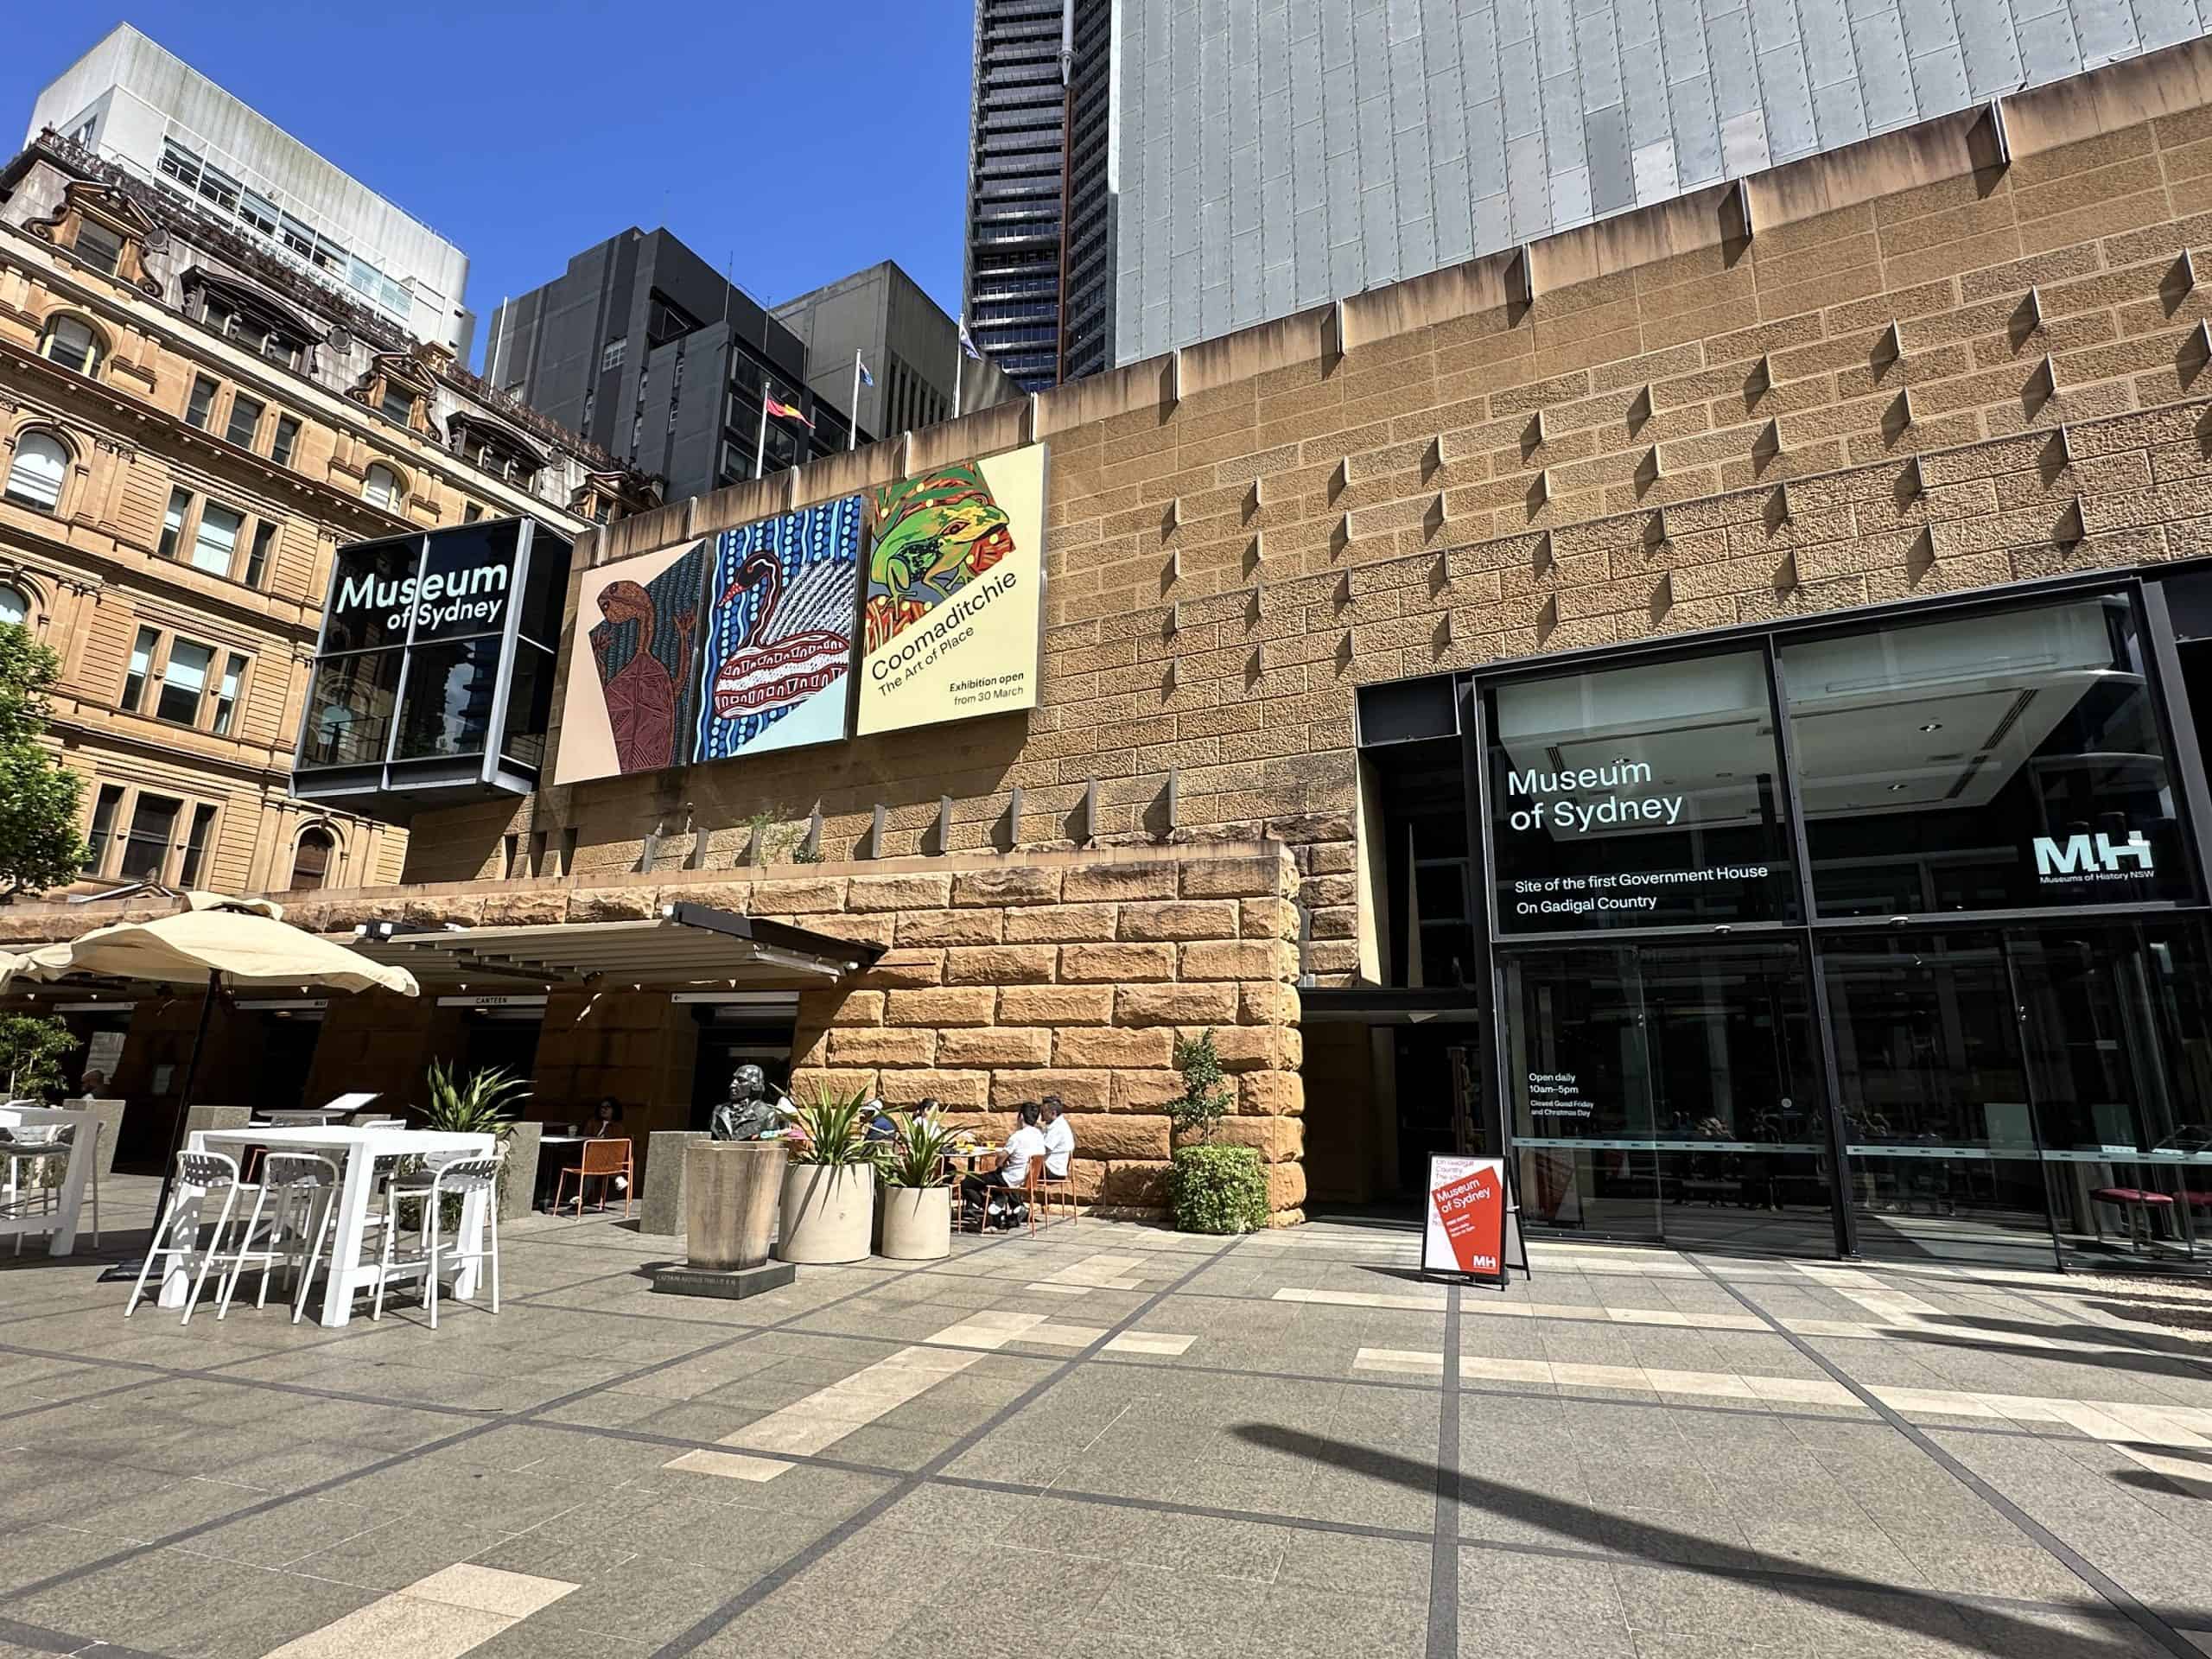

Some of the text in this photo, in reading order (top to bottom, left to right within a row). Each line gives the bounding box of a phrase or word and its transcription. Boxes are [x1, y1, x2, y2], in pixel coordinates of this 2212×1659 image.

[336, 563, 507, 613] Museum
[386, 598, 503, 630] of Sydney
[872, 572, 1016, 681] Coomaditchie
[878, 626, 975, 696] The Art of Place
[950, 671, 1024, 692] Exhibition open
[954, 685, 1024, 706] from 30 March
[1508, 761, 1652, 796] Museum
[1510, 795, 1682, 832] of Sydney
[2032, 830, 2153, 874] MH
[1515, 865, 1768, 893] Site of the first Government House
[2039, 870, 2154, 884] Museums of History NSW
[1516, 894, 1657, 915] On Gadigal Country
[1529, 1072, 1576, 1084] Open daily
[1577, 1109, 1591, 1118] Day
[1436, 1179, 1480, 1202] Museum
[1441, 1187, 1491, 1213] of Sydney
[1472, 1255, 1496, 1268] MH
